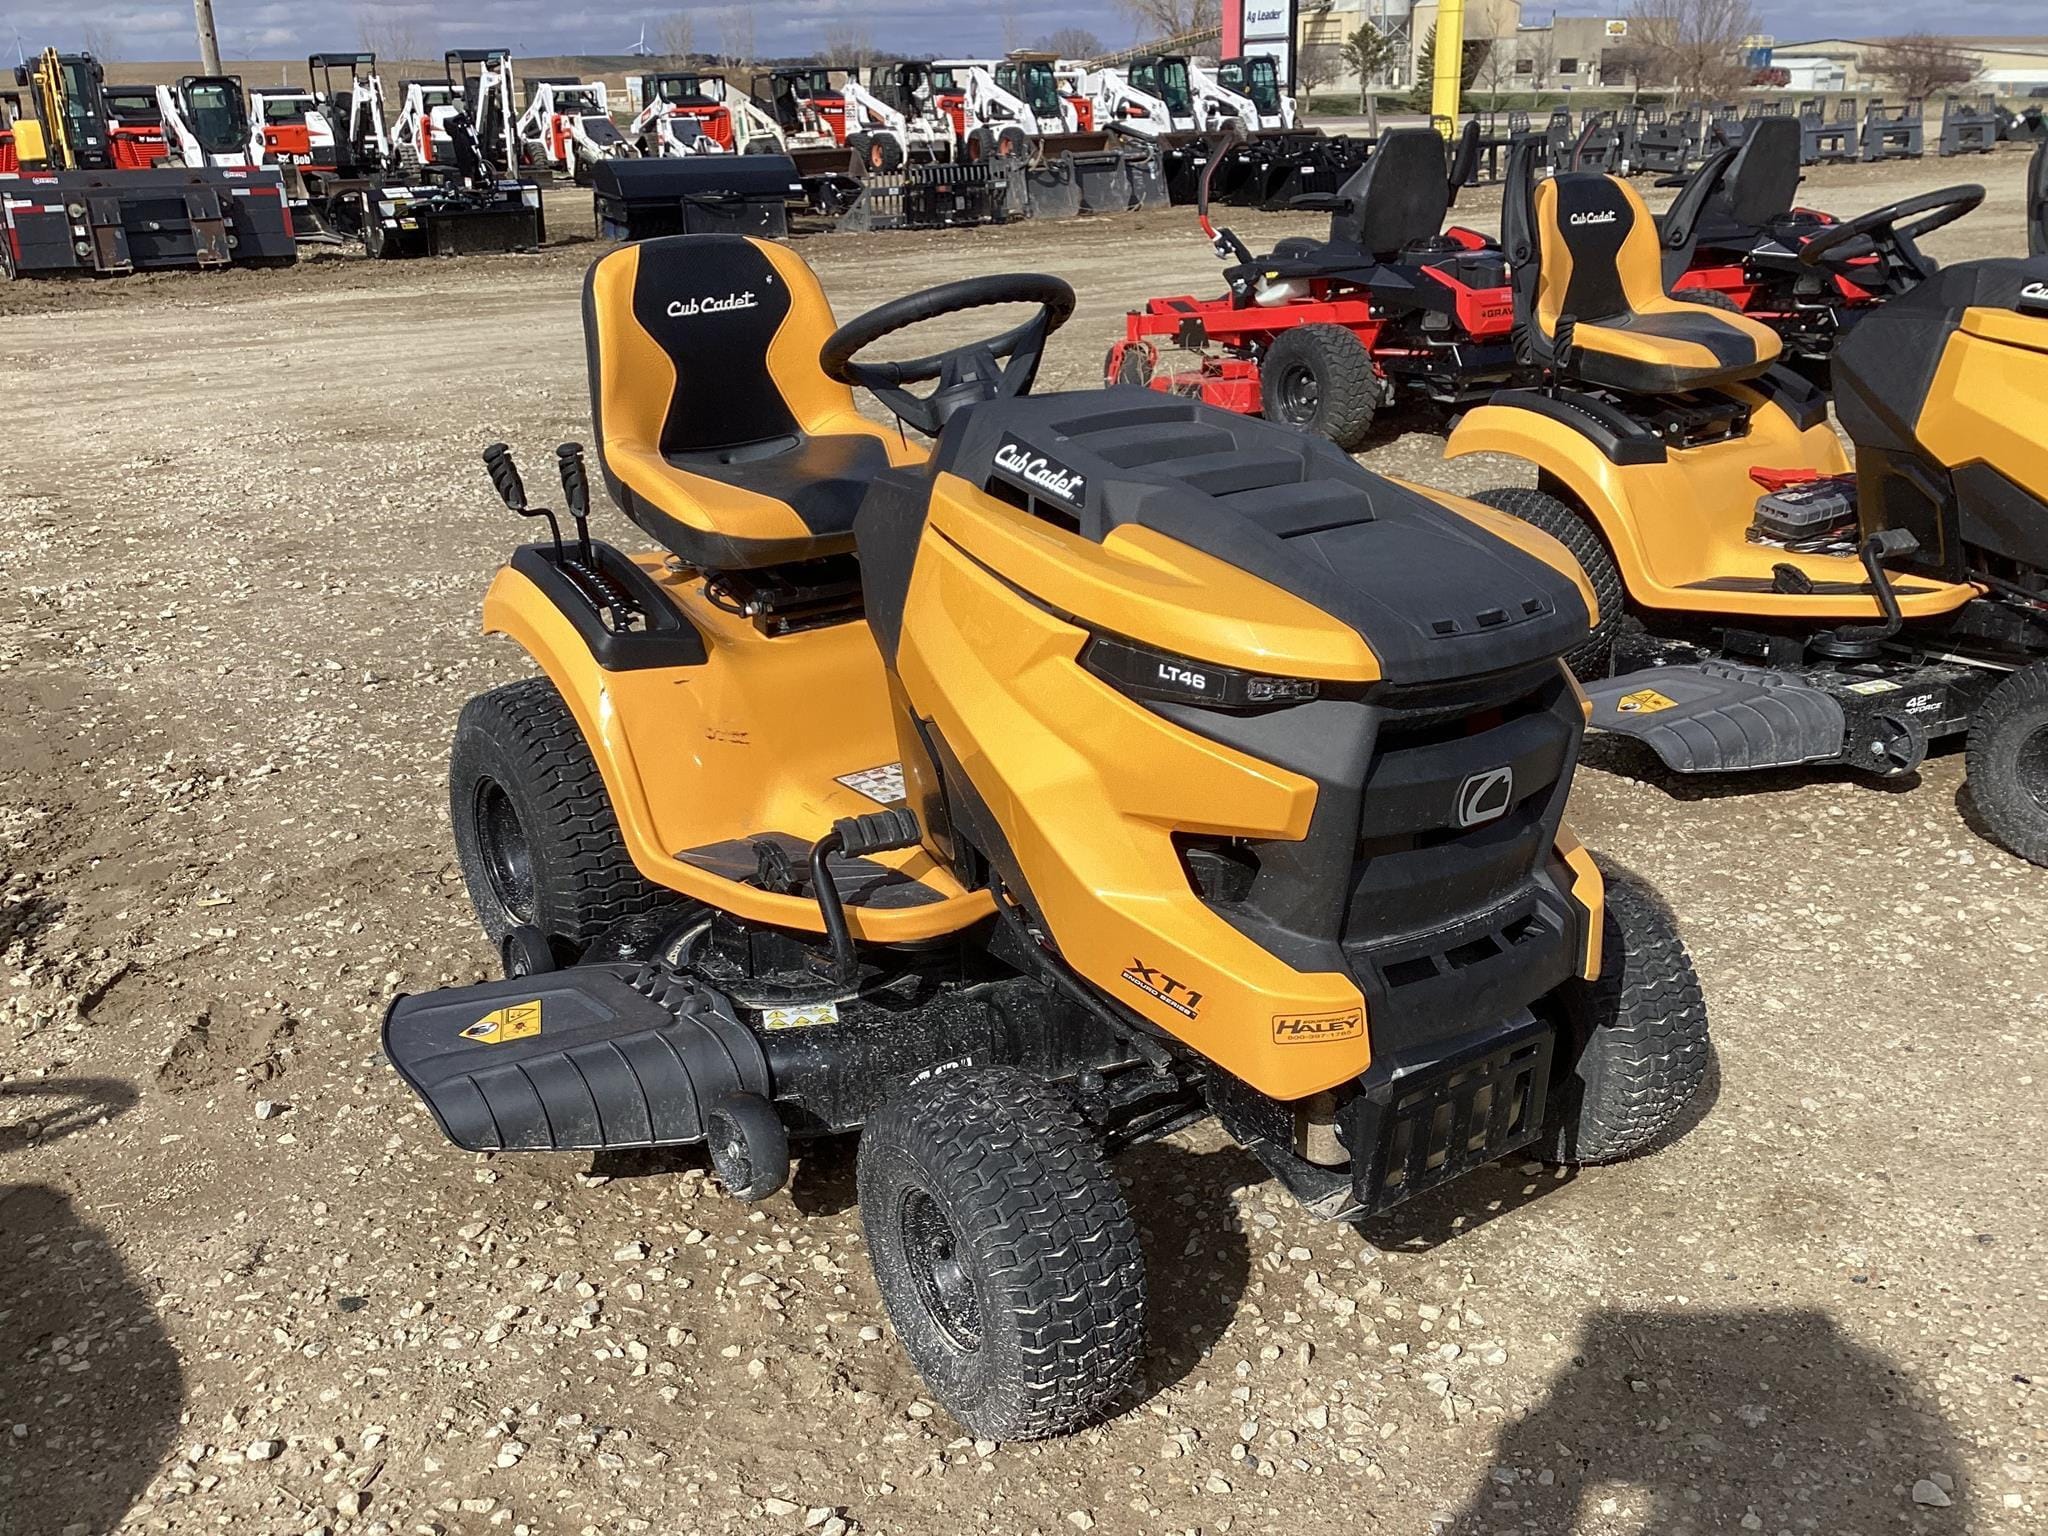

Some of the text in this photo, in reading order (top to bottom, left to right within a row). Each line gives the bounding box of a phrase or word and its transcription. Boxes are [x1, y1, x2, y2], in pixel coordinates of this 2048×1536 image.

[1246, 9, 1282, 23] Ag Leader
[292, 154, 311, 165] Bob
[1570, 210, 1616, 225] Cub Cadet
[2021, 282, 2048, 300] Cu
[667, 290, 757, 317] Cub Cadet
[1487, 308, 1513, 318] GRAV
[994, 444, 1084, 500] Cub Cadet
[1158, 663, 1206, 690] LT46
[1904, 702, 1943, 715] OFORCE
[1124, 956, 1203, 1009] XT1
[1122, 972, 1191, 1016] ENDURO SERIES
[1276, 1017, 1361, 1035] HALEY
